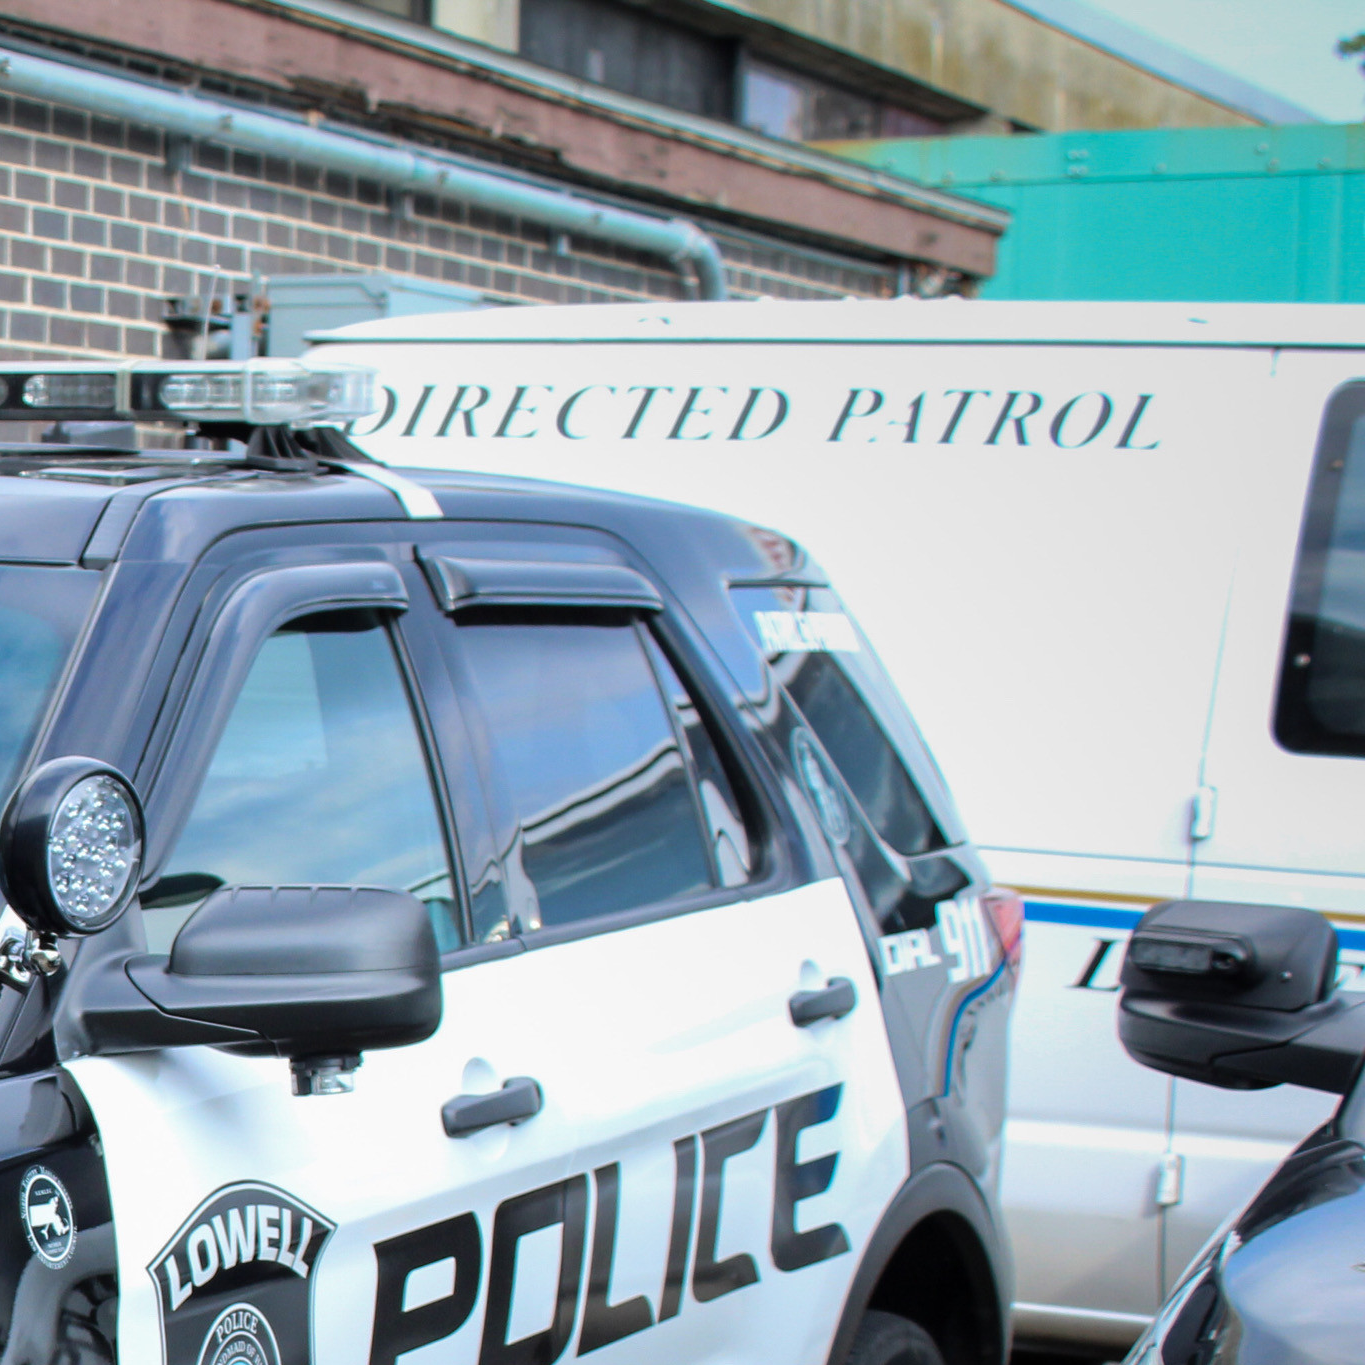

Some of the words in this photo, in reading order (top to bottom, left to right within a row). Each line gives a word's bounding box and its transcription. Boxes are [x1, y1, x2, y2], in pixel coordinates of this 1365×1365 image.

[344, 384, 790, 441] DIRECTED
[826, 387, 1160, 450] PATROL
[935, 896, 991, 984] 911
[164, 1203, 313, 1312] LOWELL
[216, 1311, 259, 1342] POLICE
